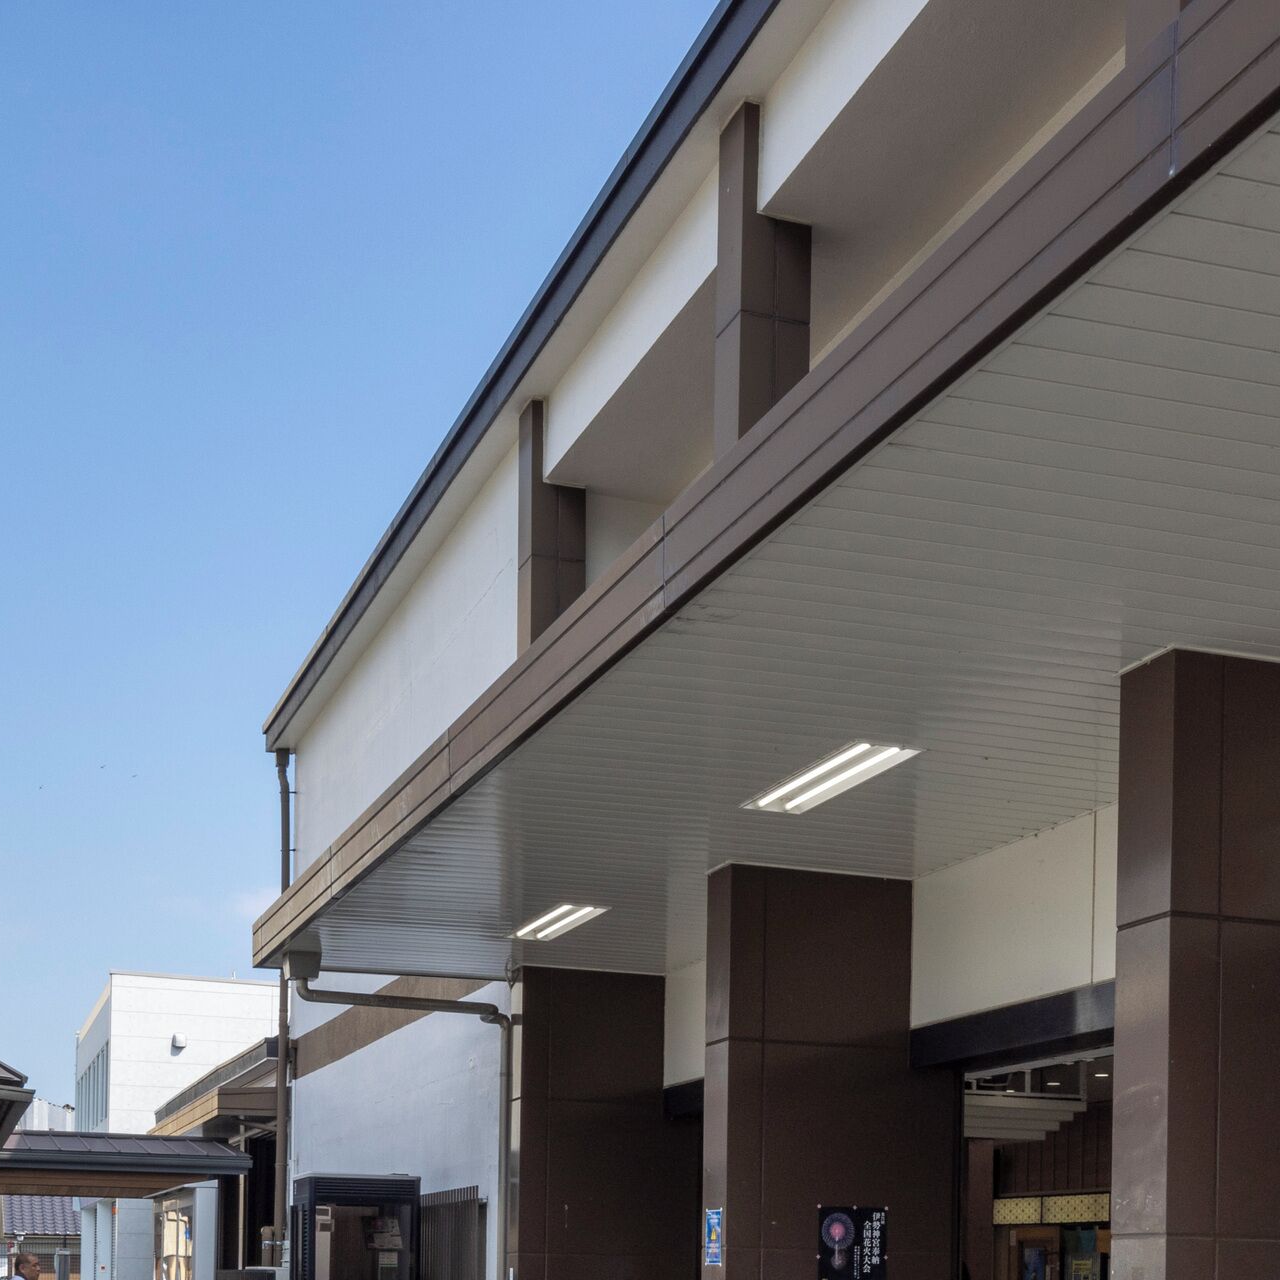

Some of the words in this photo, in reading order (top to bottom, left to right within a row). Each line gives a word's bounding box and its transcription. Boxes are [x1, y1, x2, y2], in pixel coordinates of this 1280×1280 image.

[863, 1220, 872, 1273] 全国花火大会
